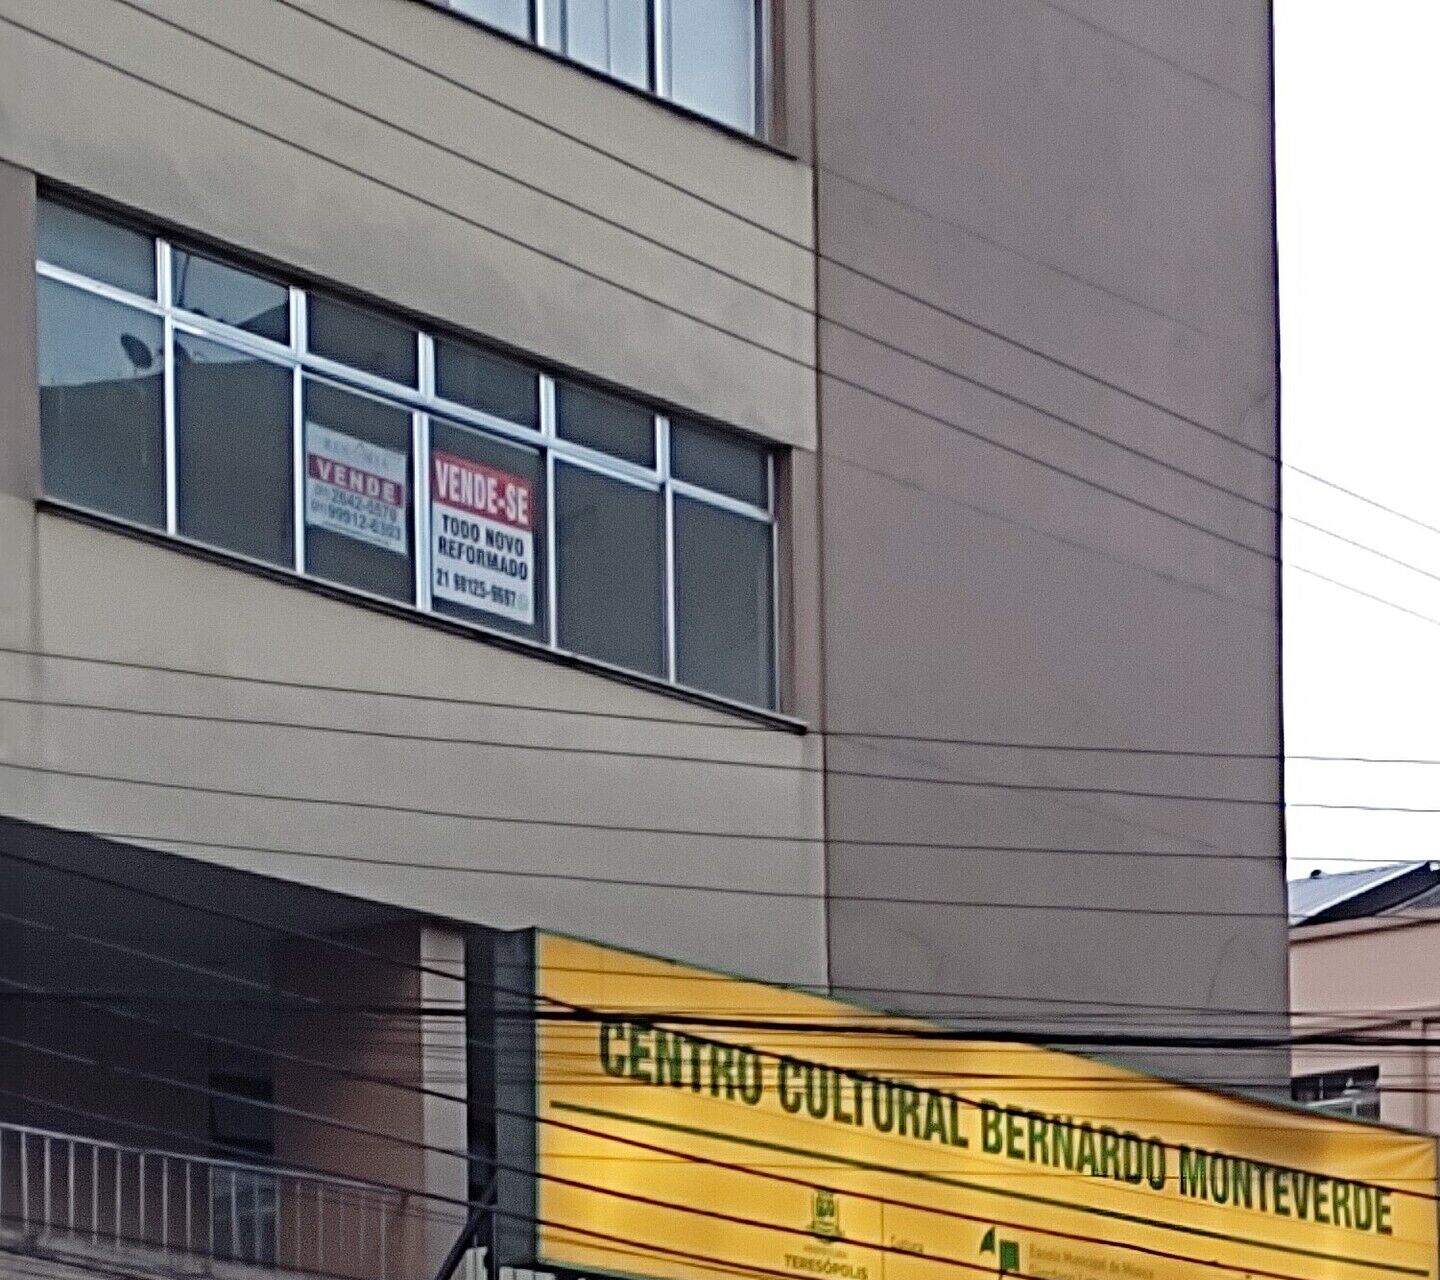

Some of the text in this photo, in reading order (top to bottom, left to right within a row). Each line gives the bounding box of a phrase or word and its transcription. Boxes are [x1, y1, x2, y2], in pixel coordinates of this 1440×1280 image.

[316, 459, 394, 502] VENDE
[435, 460, 528, 525] VENDE-SE
[442, 515, 524, 556] TODO NOVO
[438, 536, 528, 580] REFORMADO
[600, 1021, 1393, 1236] CENTRO CULTURAL BERNARDO MONTEVERDE
